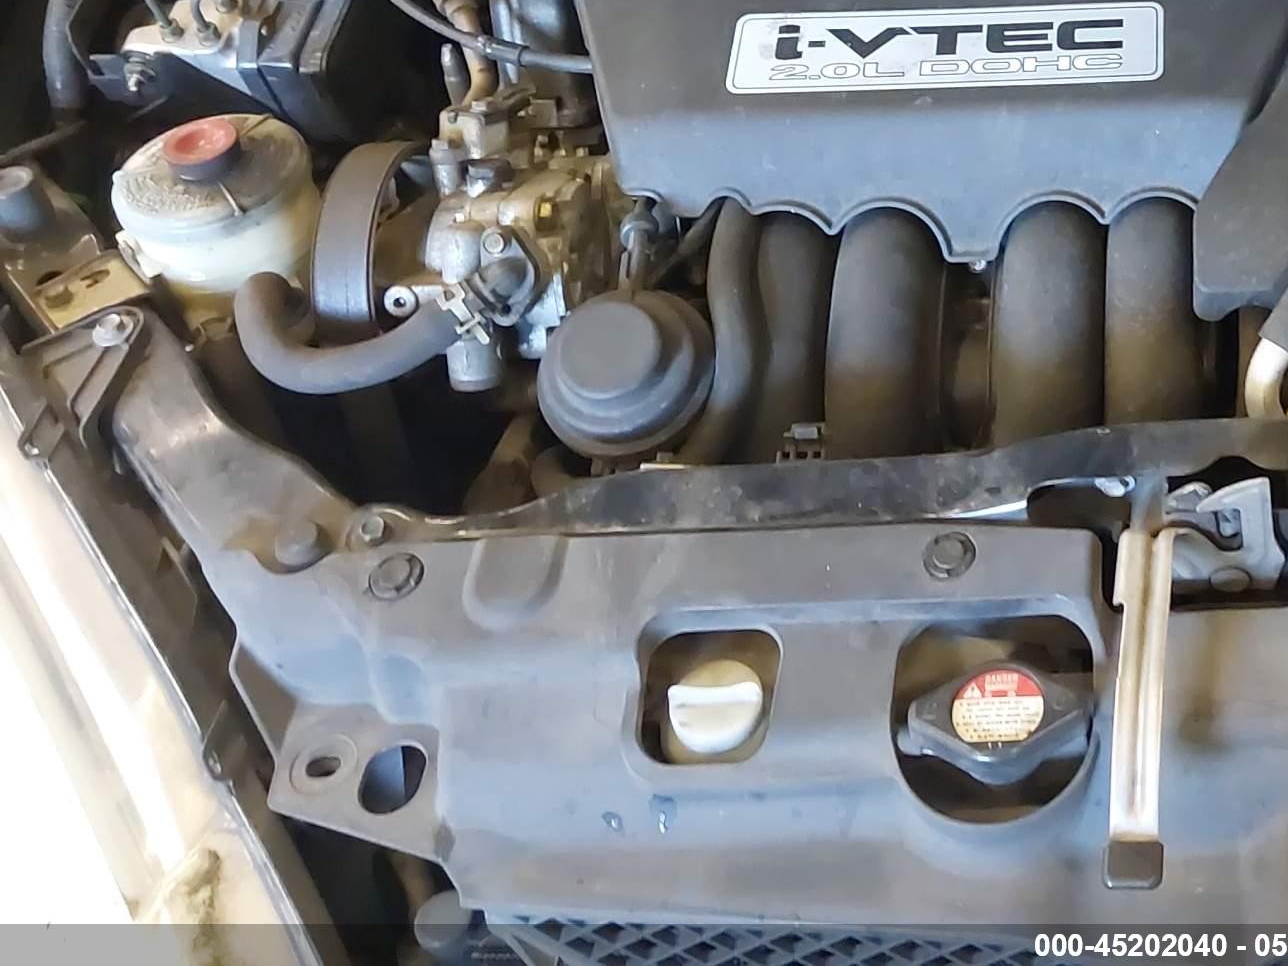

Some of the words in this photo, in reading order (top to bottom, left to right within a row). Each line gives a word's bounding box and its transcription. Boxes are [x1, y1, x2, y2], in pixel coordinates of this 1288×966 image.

[774, 18, 1123, 61] i-VTEC
[768, 62, 905, 81] 2.0L
[919, 53, 1123, 77] DOHC
